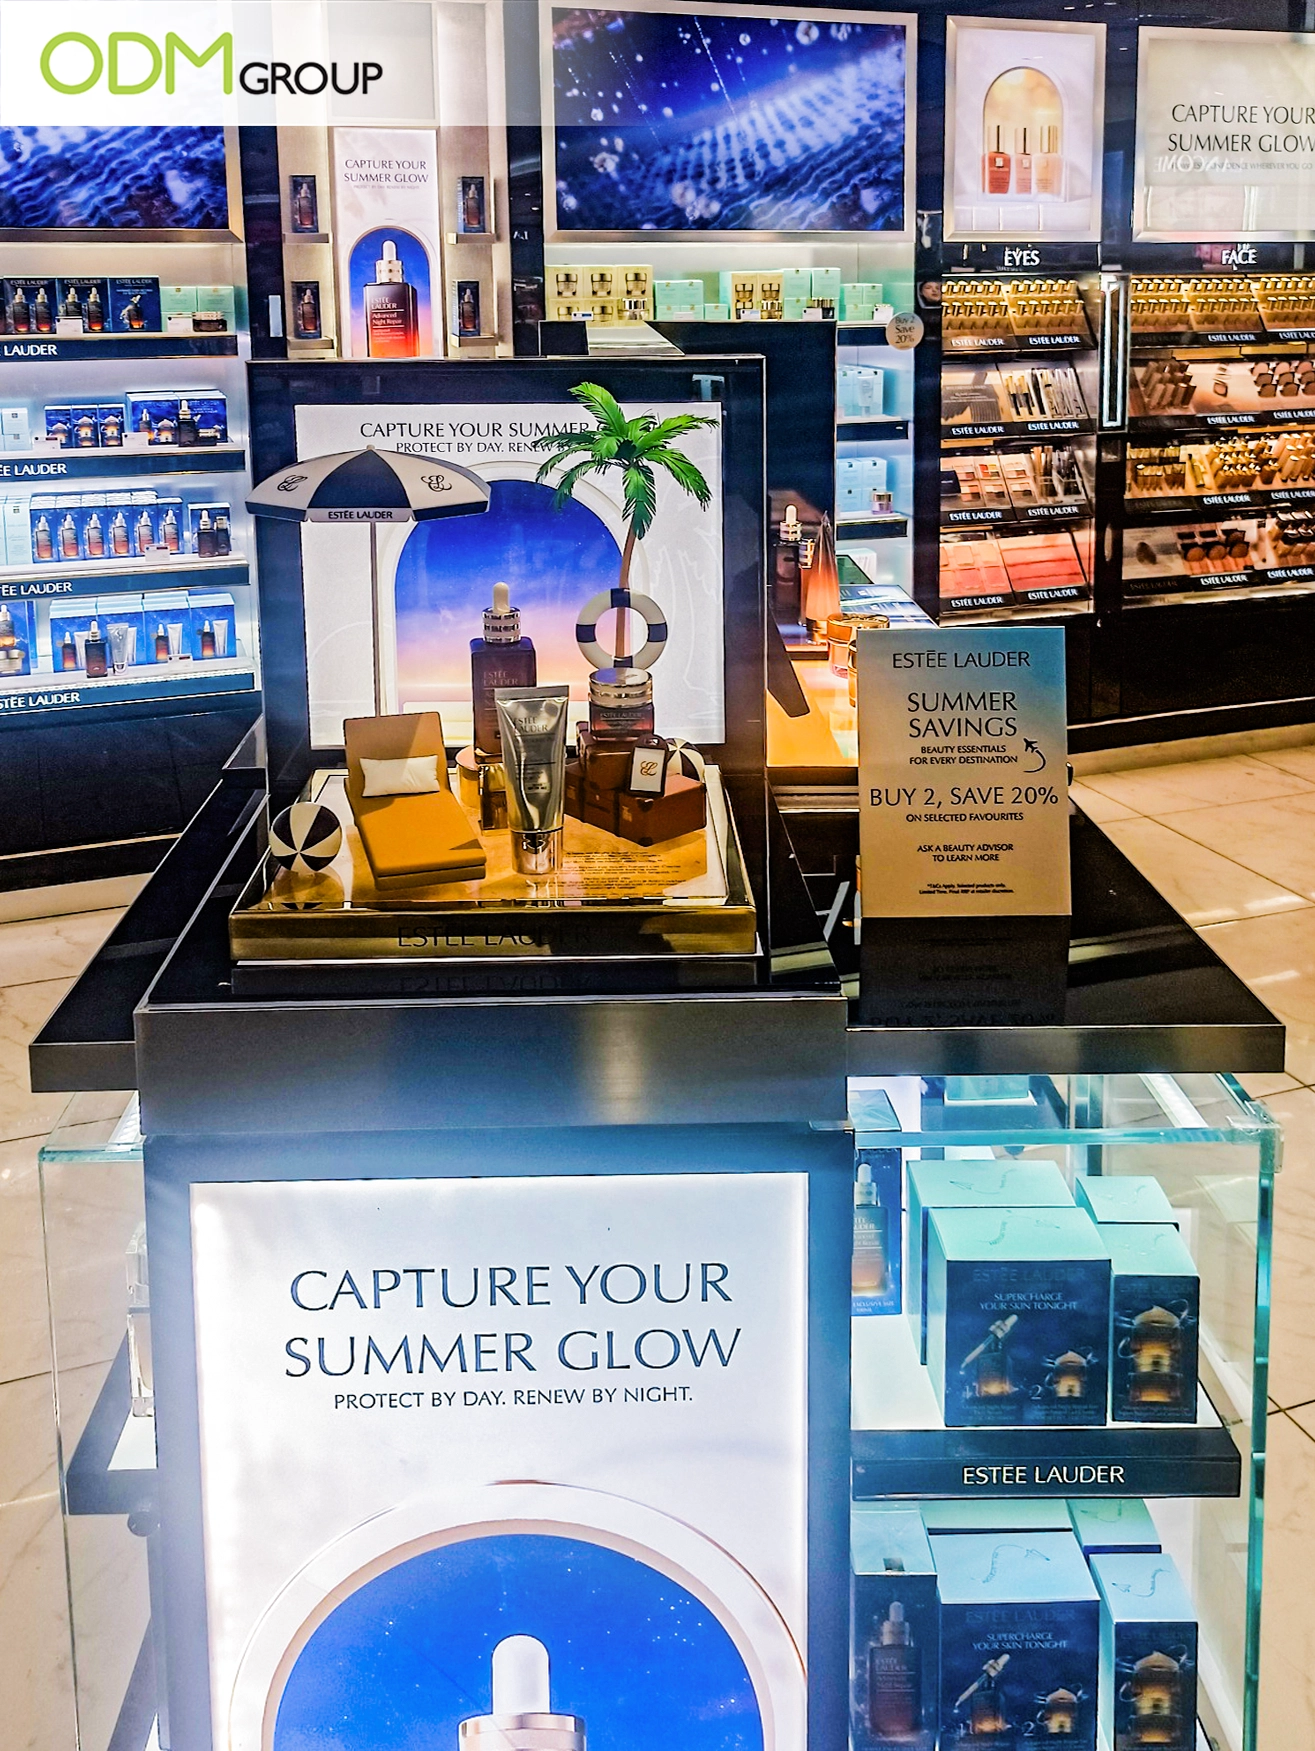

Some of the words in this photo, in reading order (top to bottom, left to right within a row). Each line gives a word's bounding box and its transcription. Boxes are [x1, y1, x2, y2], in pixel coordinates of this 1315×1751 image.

[1172, 104, 1258, 123] CAPTURE
[1263, 106, 1315, 124] YOUR
[1168, 133, 1251, 151] SUMMER
[1258, 134, 1315, 152] GLOW
[345, 159, 393, 169] CAPTURE
[395, 160, 427, 170] YOUR
[344, 173, 391, 182] SUMMER
[394, 174, 429, 183] GLOW
[1004, 250, 1040, 266] EYES
[1222, 249, 1257, 265] FACE
[895, 325, 915, 333] Save
[895, 334, 915, 343] 20%
[974, 338, 1004, 346] LAUDER
[1051, 335, 1081, 344] LAUDER
[4, 345, 57, 356] LAUDER
[1227, 415, 1255, 424] LAUDER
[360, 423, 445, 438] CAPTURE
[449, 422, 502, 438] YOUR
[974, 425, 1004, 434] LAUDER
[1049, 421, 1080, 430] LAUDER
[396, 442, 453, 453] PROTECT
[457, 442, 473, 452] BY
[477, 442, 504, 453] DAY.
[14, 463, 67, 476] LAUDER
[1223, 494, 1252, 504] LAUDER
[357, 511, 393, 519] LAUDER
[972, 511, 1003, 520] LAUDER
[1050, 506, 1079, 515] LAUDER
[1287, 568, 1315, 577] LAUDER
[1220, 574, 1249, 584] LAUDER
[20, 582, 73, 595] LAUDER
[1049, 589, 1079, 598] LAUDER
[973, 596, 1003, 606] LAUDER
[954, 651, 1031, 668] LAUDER
[29, 692, 81, 707] LAUDER
[907, 691, 1018, 712] SUMMER
[909, 717, 1017, 738] SAVINGS
[921, 746, 955, 754] BEAUTY
[957, 745, 1006, 754] ESSENTIALS
[910, 756, 928, 765] FOR
[930, 756, 957, 765] EVERY
[958, 755, 1018, 764] DESTINATION
[870, 788, 916, 806] BUY
[924, 788, 942, 809] 2,
[950, 787, 1004, 805] SAVE
[1011, 786, 1059, 804] 20%
[906, 814, 922, 823] ON
[924, 813, 967, 822] SELECTED
[969, 812, 1024, 821] FAVOURITES
[943, 844, 975, 852] BEAUTY
[976, 843, 1014, 852] ADVISOR
[932, 854, 945, 862] TO
[946, 854, 973, 862] LEARN
[291, 1266, 551, 1311] CAPTURE
[565, 1262, 733, 1305] YOUR
[994, 1292, 1063, 1301] SUPERCHARGE
[980, 1301, 1007, 1311] YOUR
[1009, 1302, 1030, 1310] SKIN
[1033, 1301, 1078, 1310] TONIGHT
[285, 1332, 537, 1377] SUMMER
[558, 1328, 742, 1371] GLOW
[334, 1392, 425, 1410] PROTECT
[431, 1391, 458, 1408] BY
[464, 1390, 507, 1407] DAY.
[514, 1388, 585, 1406] RENEW
[593, 1387, 617, 1404] BY
[624, 1385, 694, 1404] NIGHT.
[1035, 1465, 1124, 1484] LAUDER
[987, 1632, 1053, 1641] SUPERCHARGE
[972, 1642, 1000, 1651] YOUR
[1002, 1641, 1022, 1650] SKIN
[1025, 1640, 1068, 1649] TONIGHT
